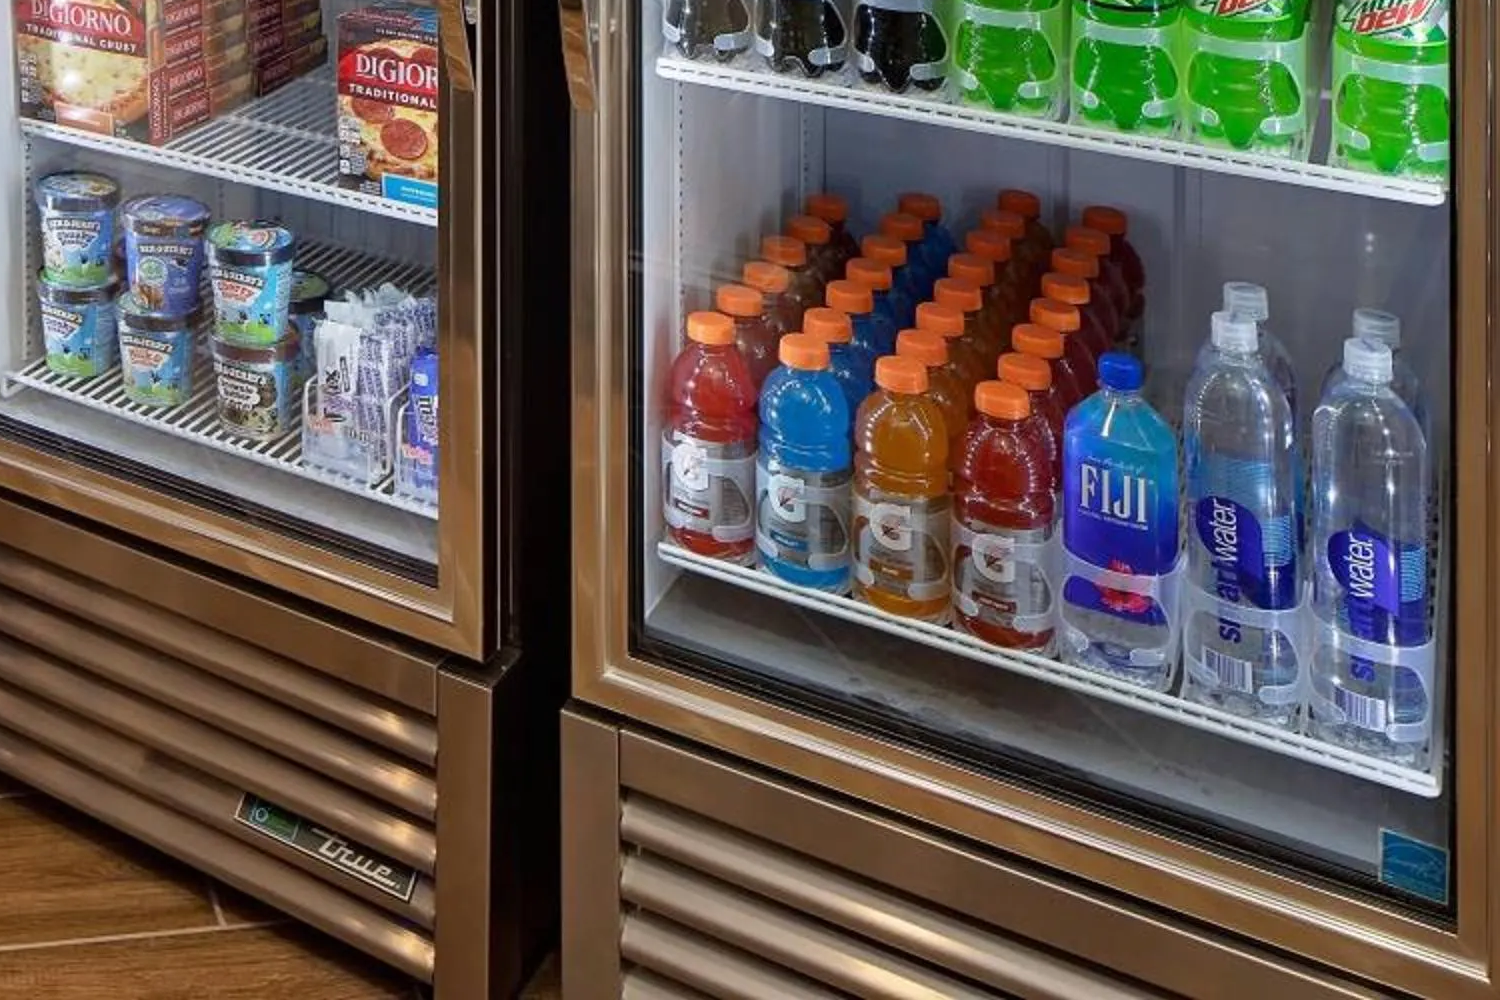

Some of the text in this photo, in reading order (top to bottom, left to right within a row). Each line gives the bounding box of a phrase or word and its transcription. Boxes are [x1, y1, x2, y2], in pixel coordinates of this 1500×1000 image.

[99, 38, 137, 53] CRUST
[355, 53, 438, 90] DIGIOR
[349, 83, 436, 108] TRADITIONAL
[1080, 463, 1148, 524] FIJI
